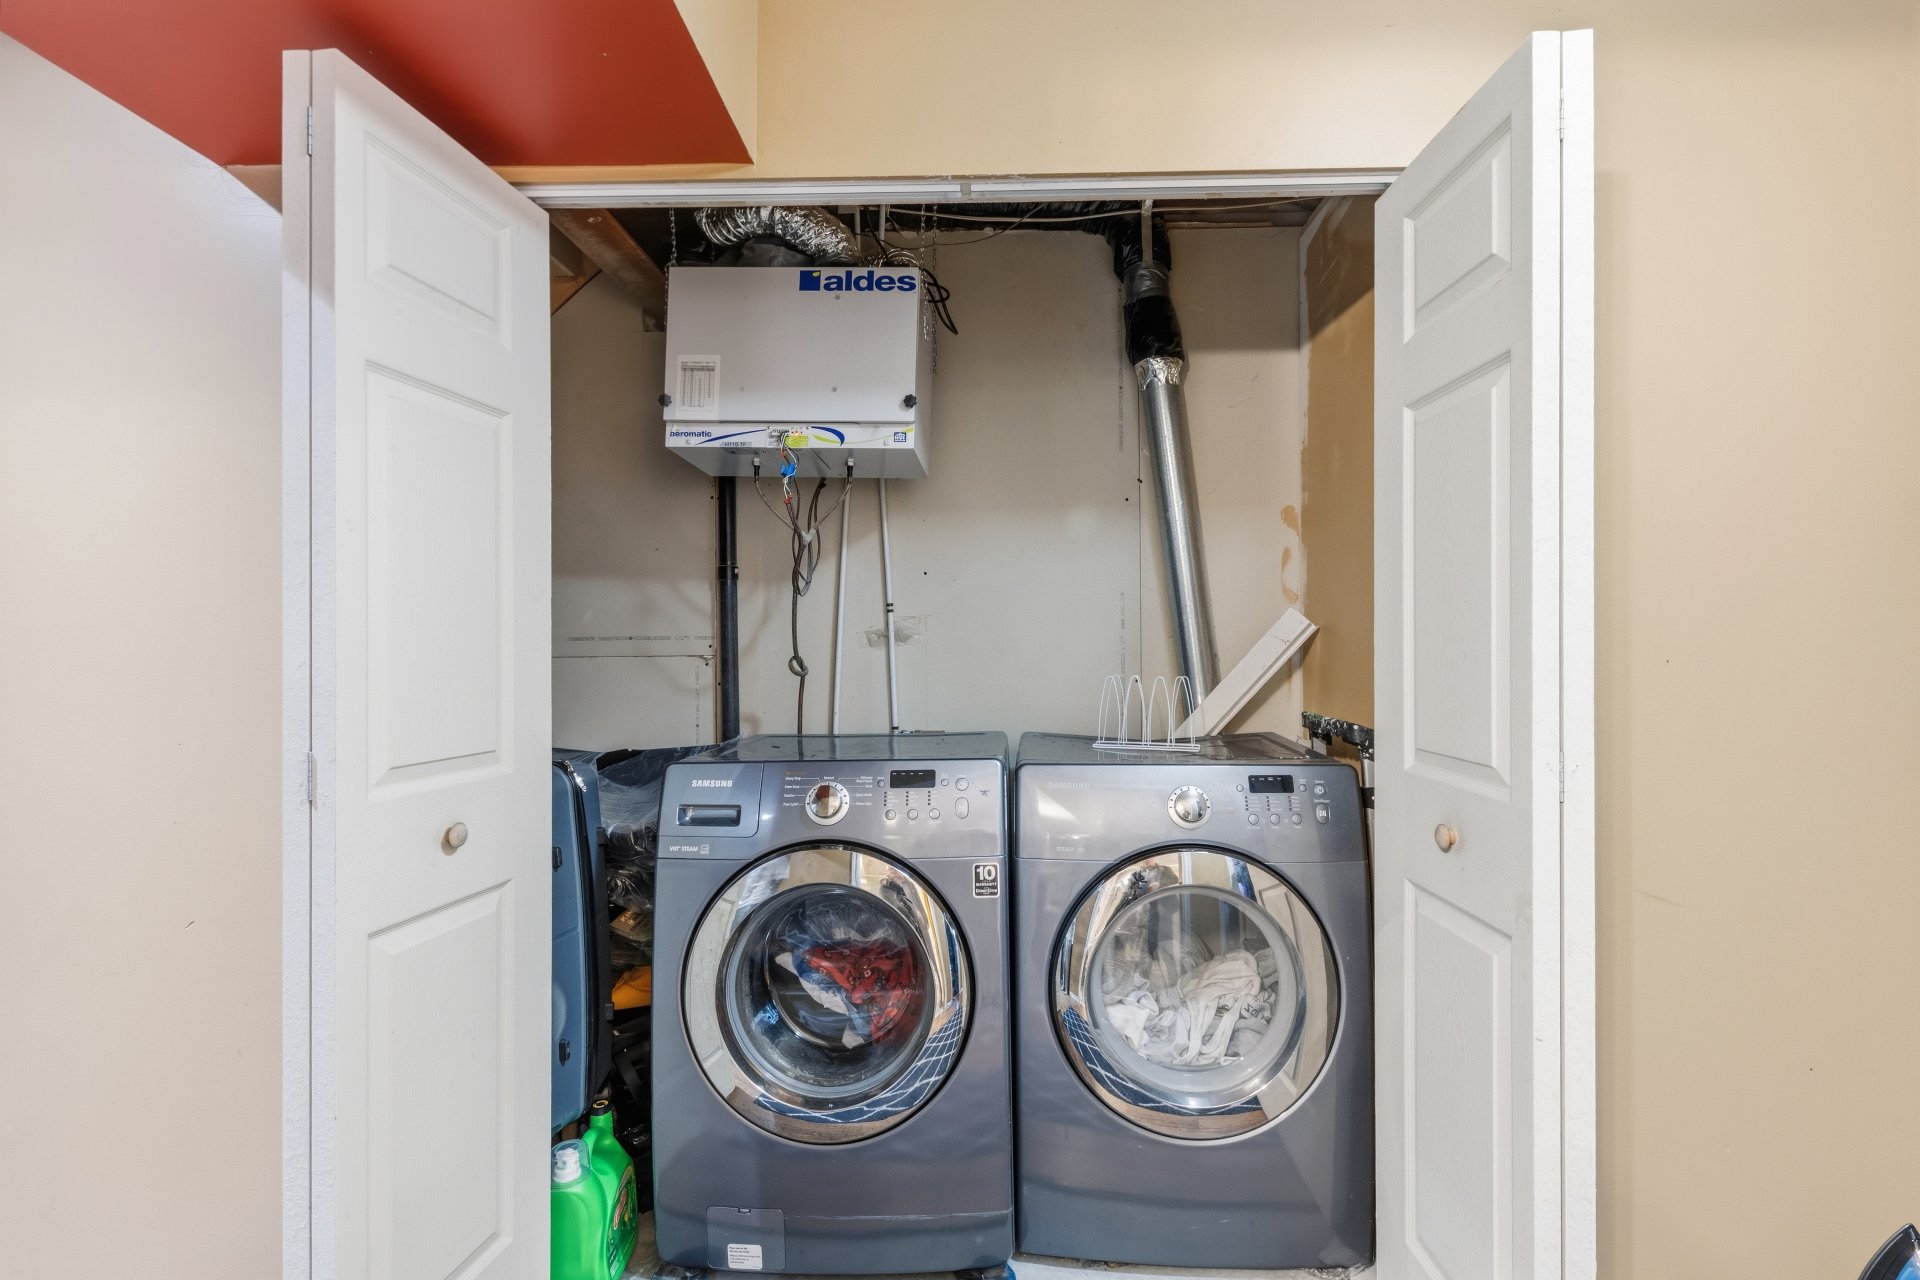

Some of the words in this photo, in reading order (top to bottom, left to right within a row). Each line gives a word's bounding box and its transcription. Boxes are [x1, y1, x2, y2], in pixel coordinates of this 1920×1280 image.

[823, 270, 917, 292] aldes
[692, 779, 733, 788] SAMSUNG
[977, 866, 995, 880] 10
